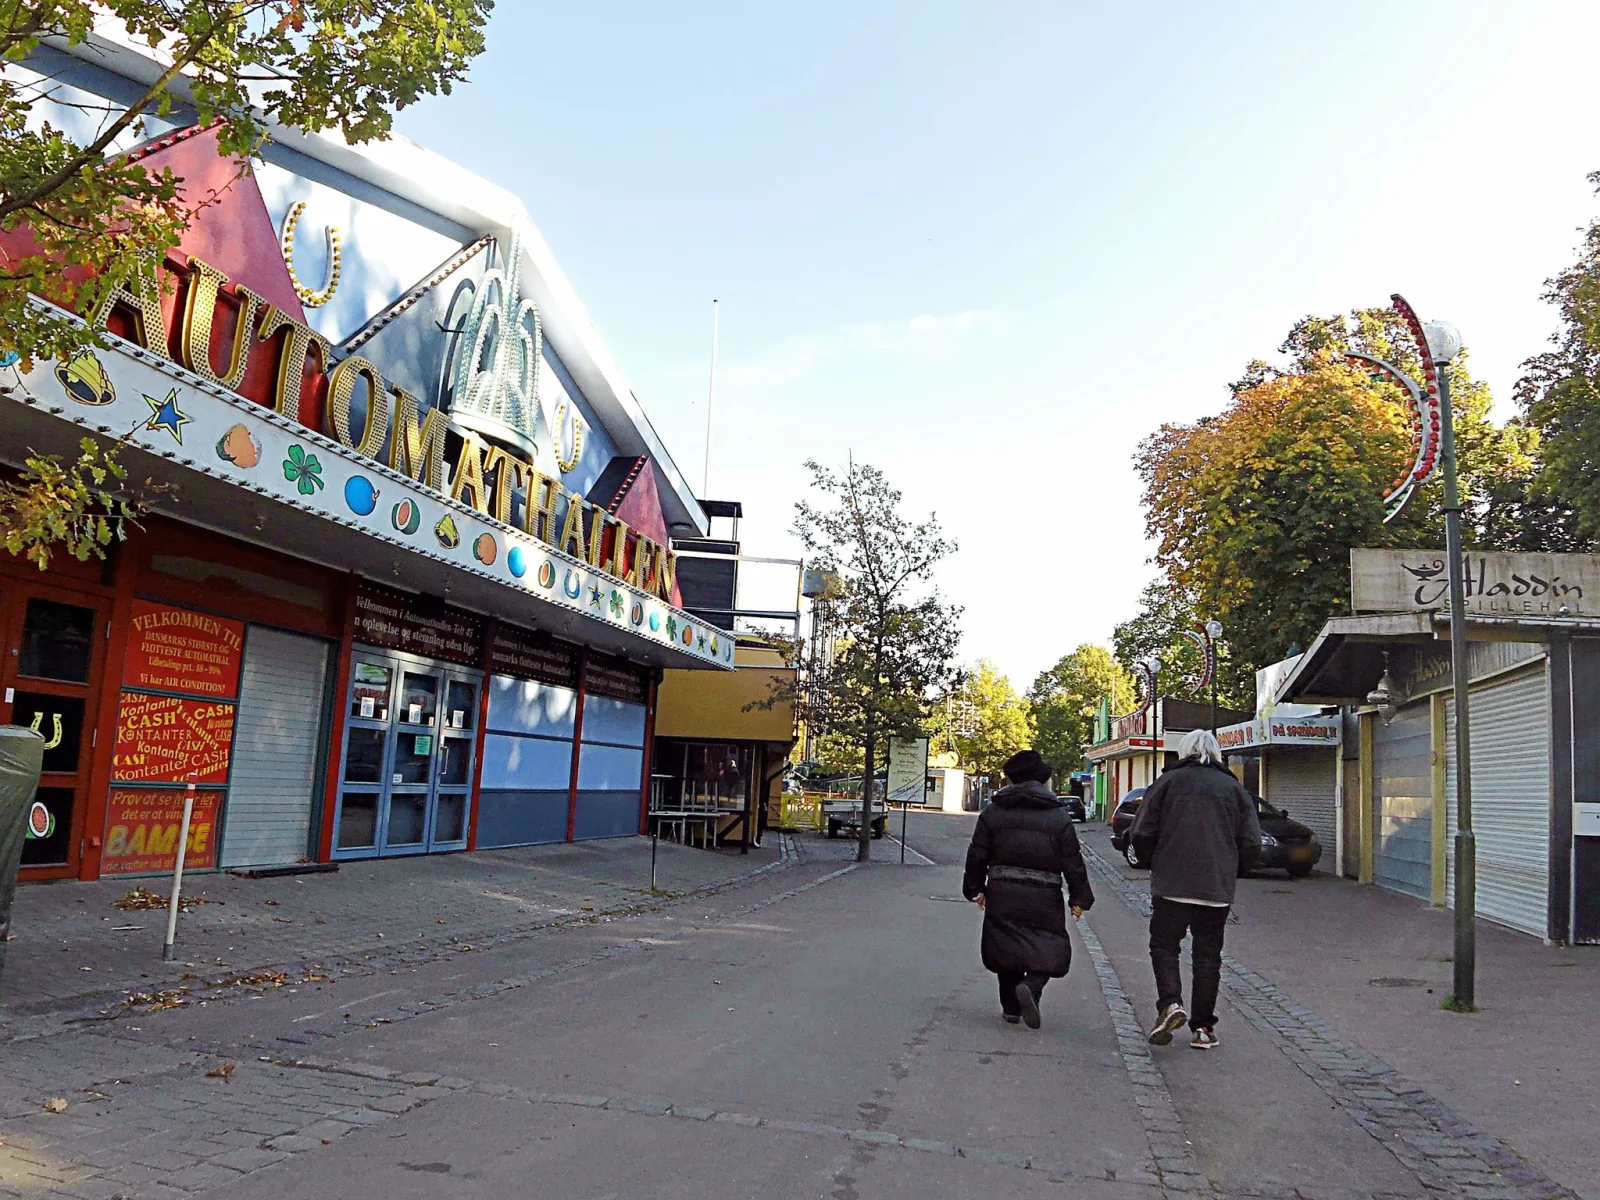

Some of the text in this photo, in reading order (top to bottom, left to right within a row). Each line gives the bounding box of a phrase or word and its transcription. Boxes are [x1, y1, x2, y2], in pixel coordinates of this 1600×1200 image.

[91, 243, 678, 606] AUTOMATHALLEN
[1414, 553, 1583, 605] Aladdin
[356, 595, 398, 618] Velkommen
[133, 611, 241, 651] VELKOMMEN TIL
[362, 618, 400, 636] oplevelse
[401, 628, 411, 641] og
[412, 631, 445, 649] stemning
[446, 639, 462, 651] uden
[145, 631, 187, 647] DANMARKS
[220, 645, 229, 655] OG
[141, 642, 230, 666] FLOTTESTE AUTOMATHAL
[140, 673, 226, 693] Vi har AIR CONDITION!
[127, 711, 176, 729] CASH
[194, 704, 233, 720] CASH
[177, 740, 205, 751] CASH
[214, 729, 232, 742] CASH
[113, 753, 150, 766] CASH
[137, 741, 189, 762] Kontanter
[191, 748, 229, 766] CASH
[114, 760, 187, 781] Kontanter
[142, 793, 157, 805] at
[158, 794, 172, 805] se
[173, 793, 200, 806] hvr
[200, 793, 215, 805] let
[121, 808, 137, 820] det
[139, 810, 150, 820] er
[151, 809, 163, 819] at
